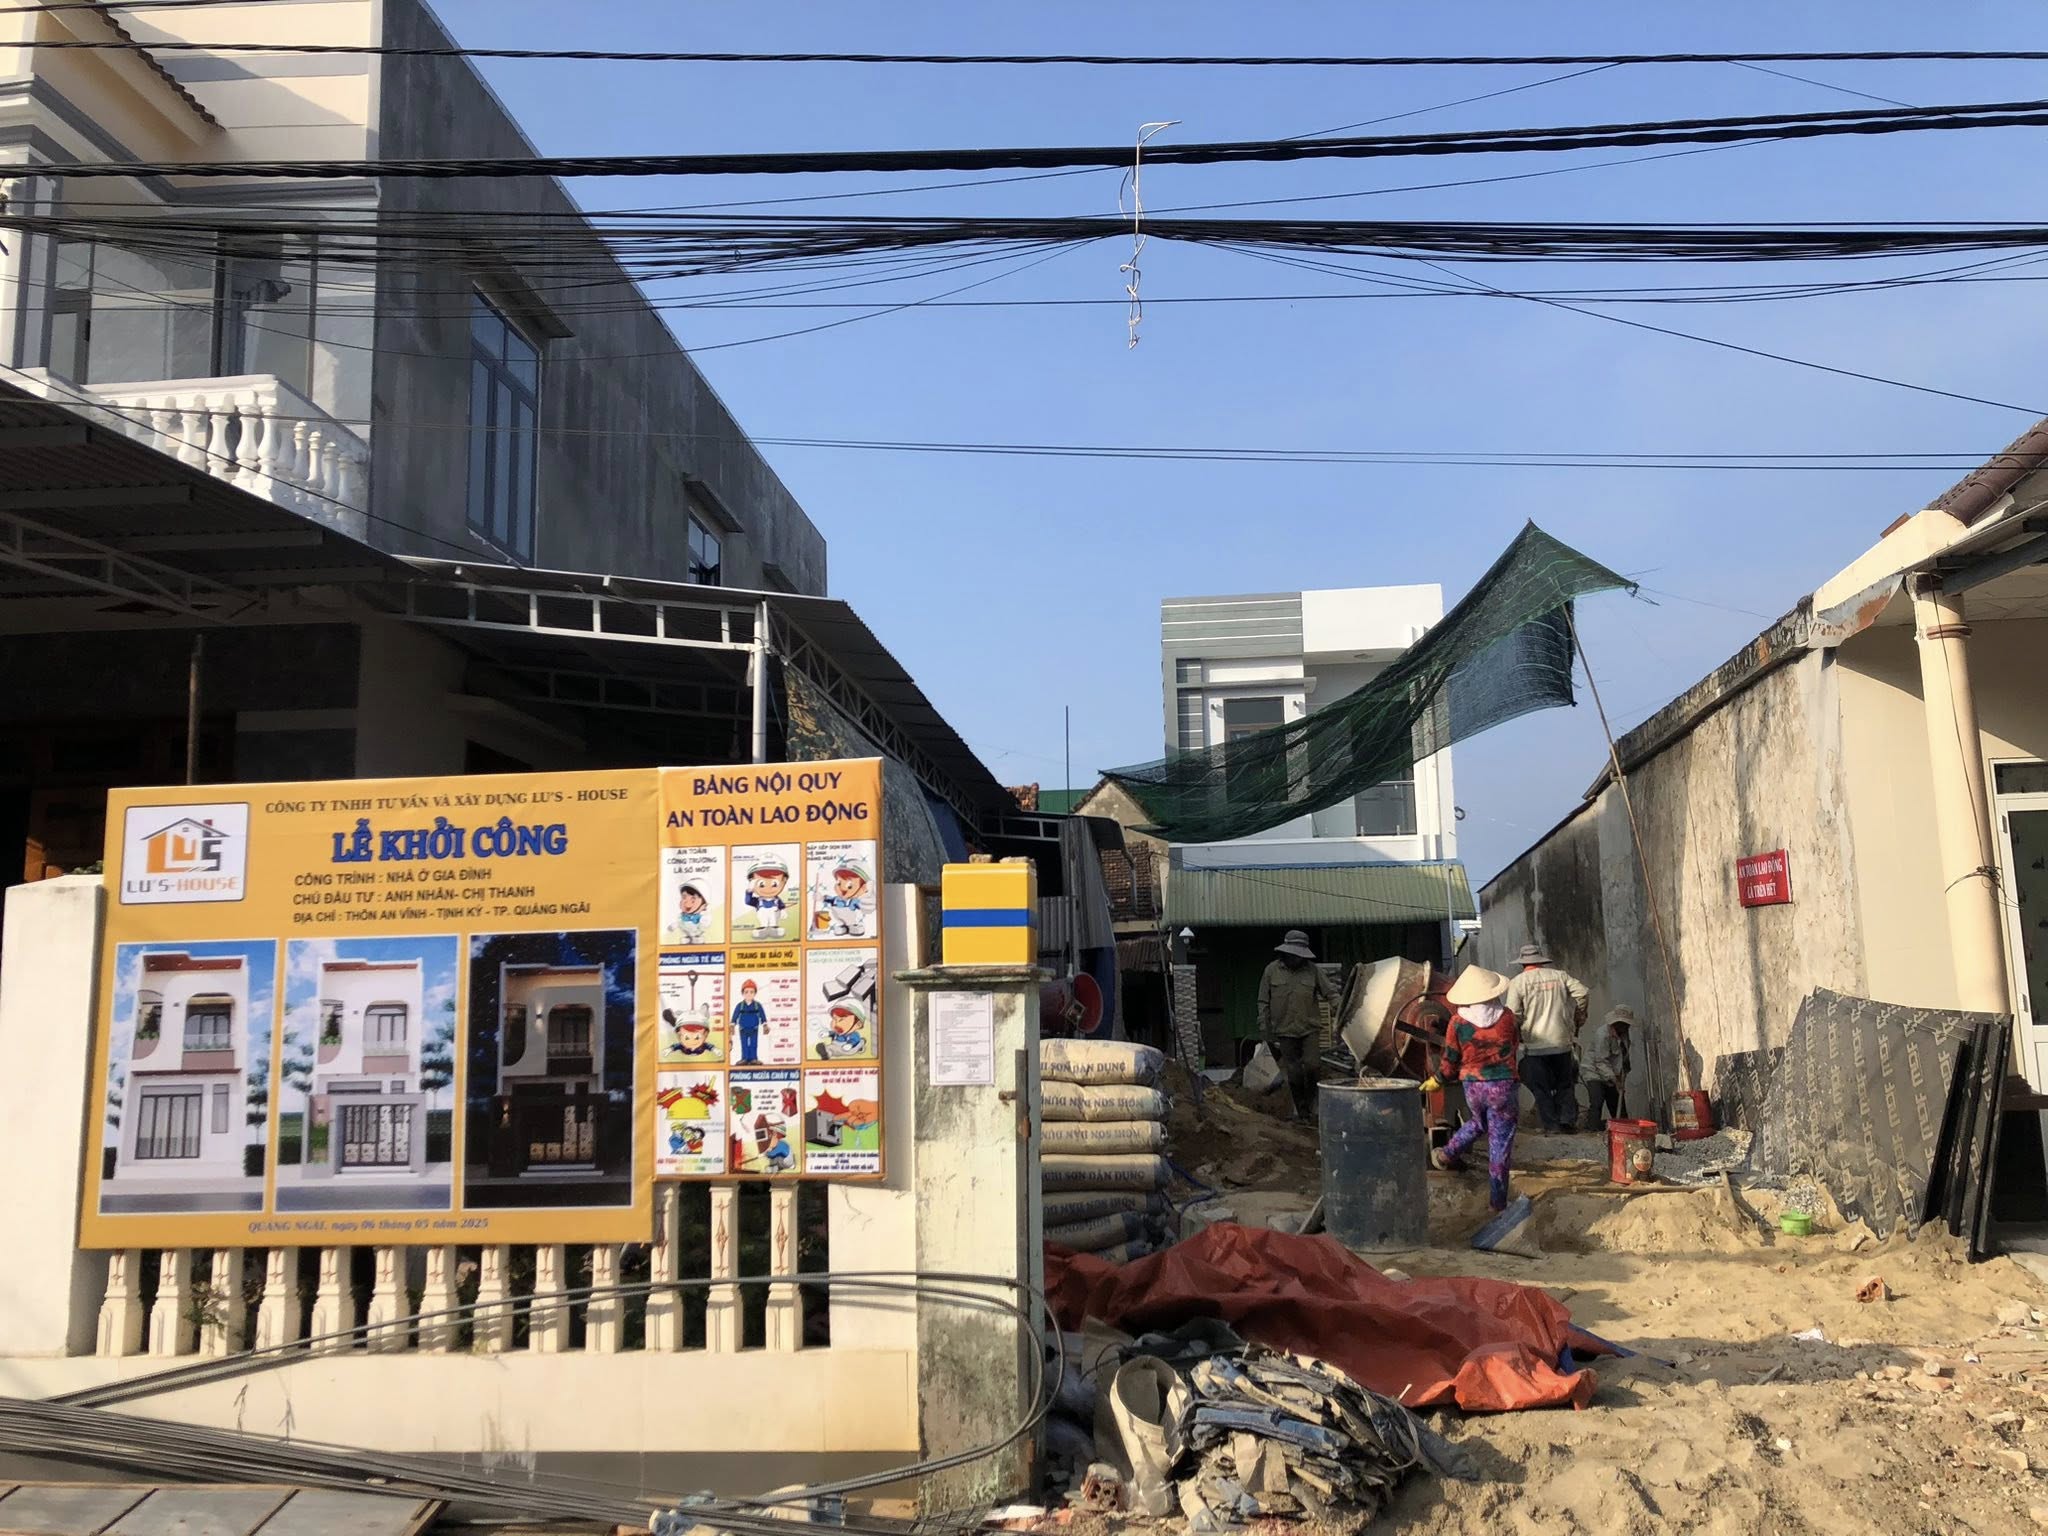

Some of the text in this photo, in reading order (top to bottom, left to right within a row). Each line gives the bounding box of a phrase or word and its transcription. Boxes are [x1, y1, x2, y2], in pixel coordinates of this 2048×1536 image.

[693, 771, 842, 795] BẢNG NỘI QUY
[265, 800, 305, 813] CÔNG
[310, 801, 327, 812] TY
[332, 799, 372, 811] TNHH
[398, 793, 429, 808] VẤN
[433, 793, 450, 807] VÀ
[455, 793, 481, 806] XÂY
[532, 791, 563, 803] LU'S
[577, 788, 628, 801] HOUSE
[666, 800, 868, 828] AN TOÀN LAO ĐỘNG
[332, 815, 568, 862] LỄ KHỞI CÔNG
